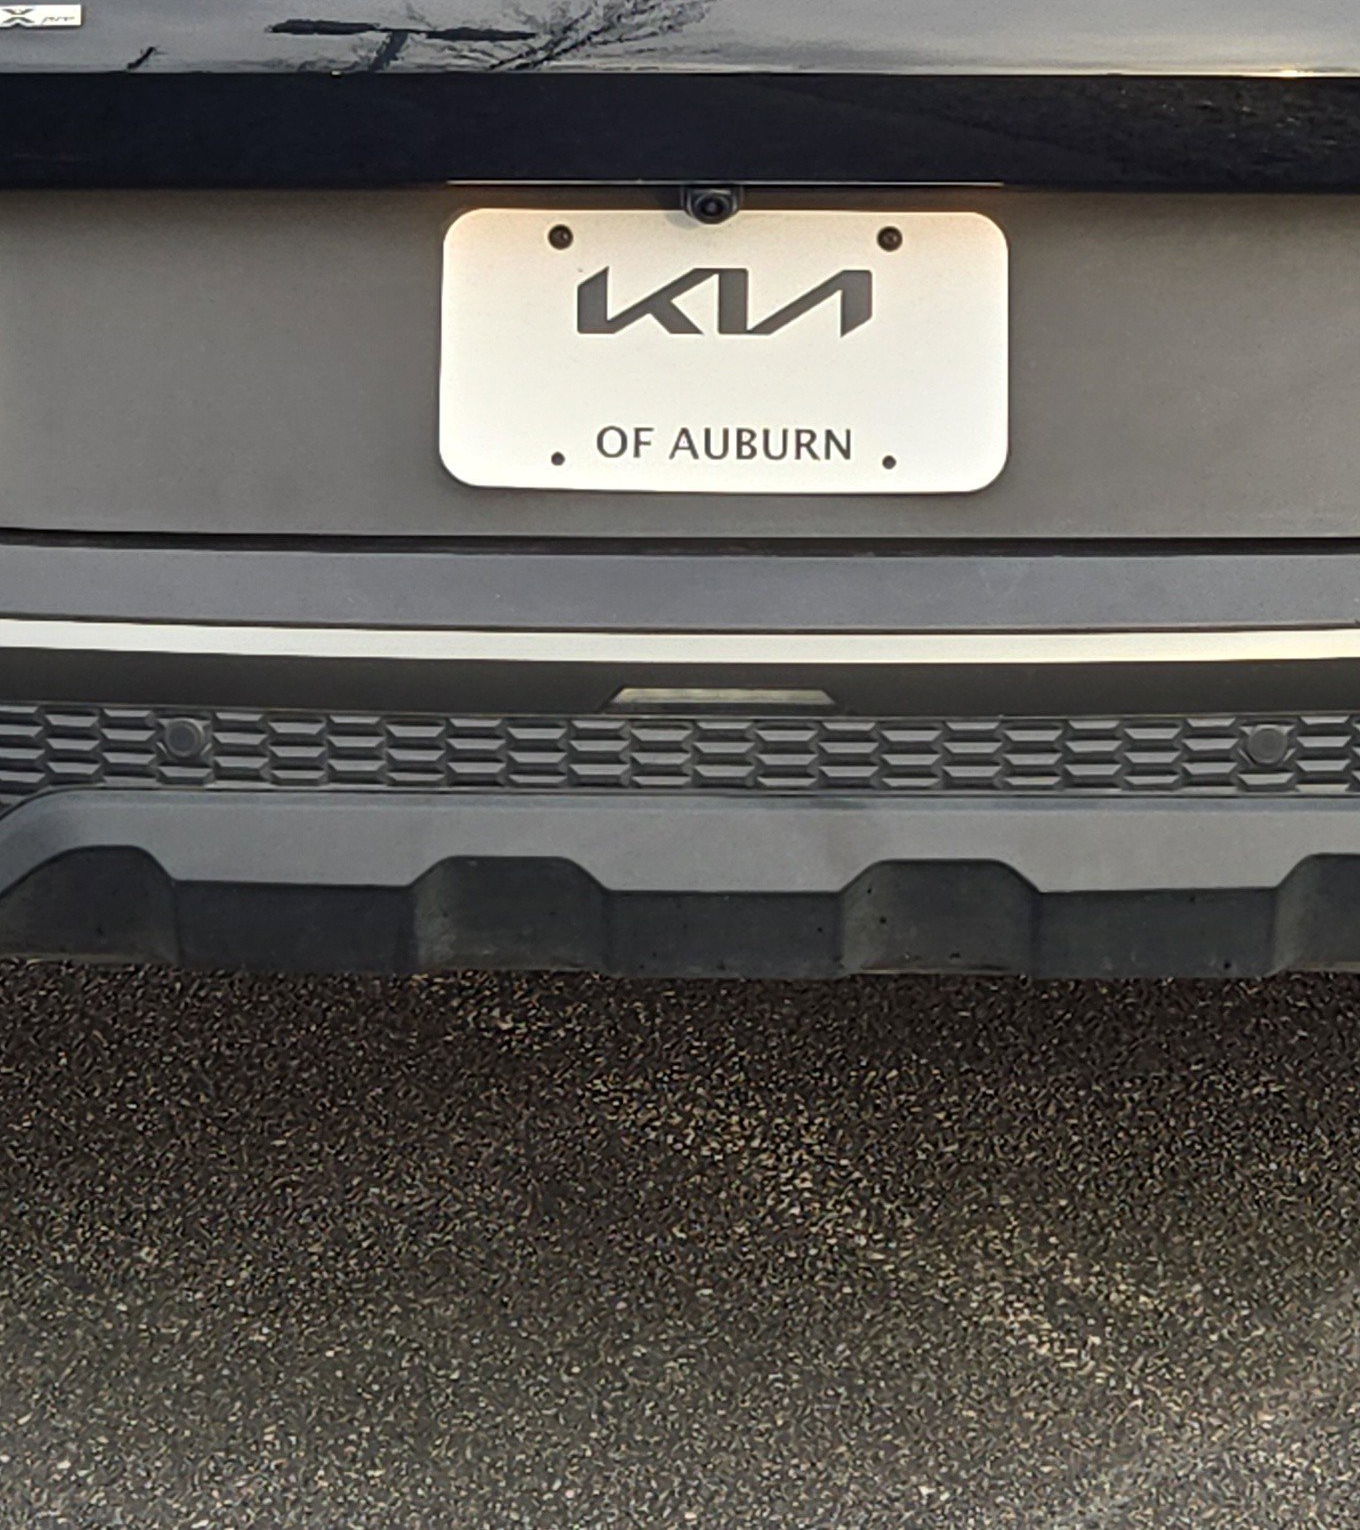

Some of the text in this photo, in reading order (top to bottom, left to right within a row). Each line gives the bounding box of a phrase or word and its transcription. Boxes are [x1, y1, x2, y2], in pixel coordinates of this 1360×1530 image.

[576, 266, 873, 337] KIA
[596, 426, 852, 461] OF AUBURN
